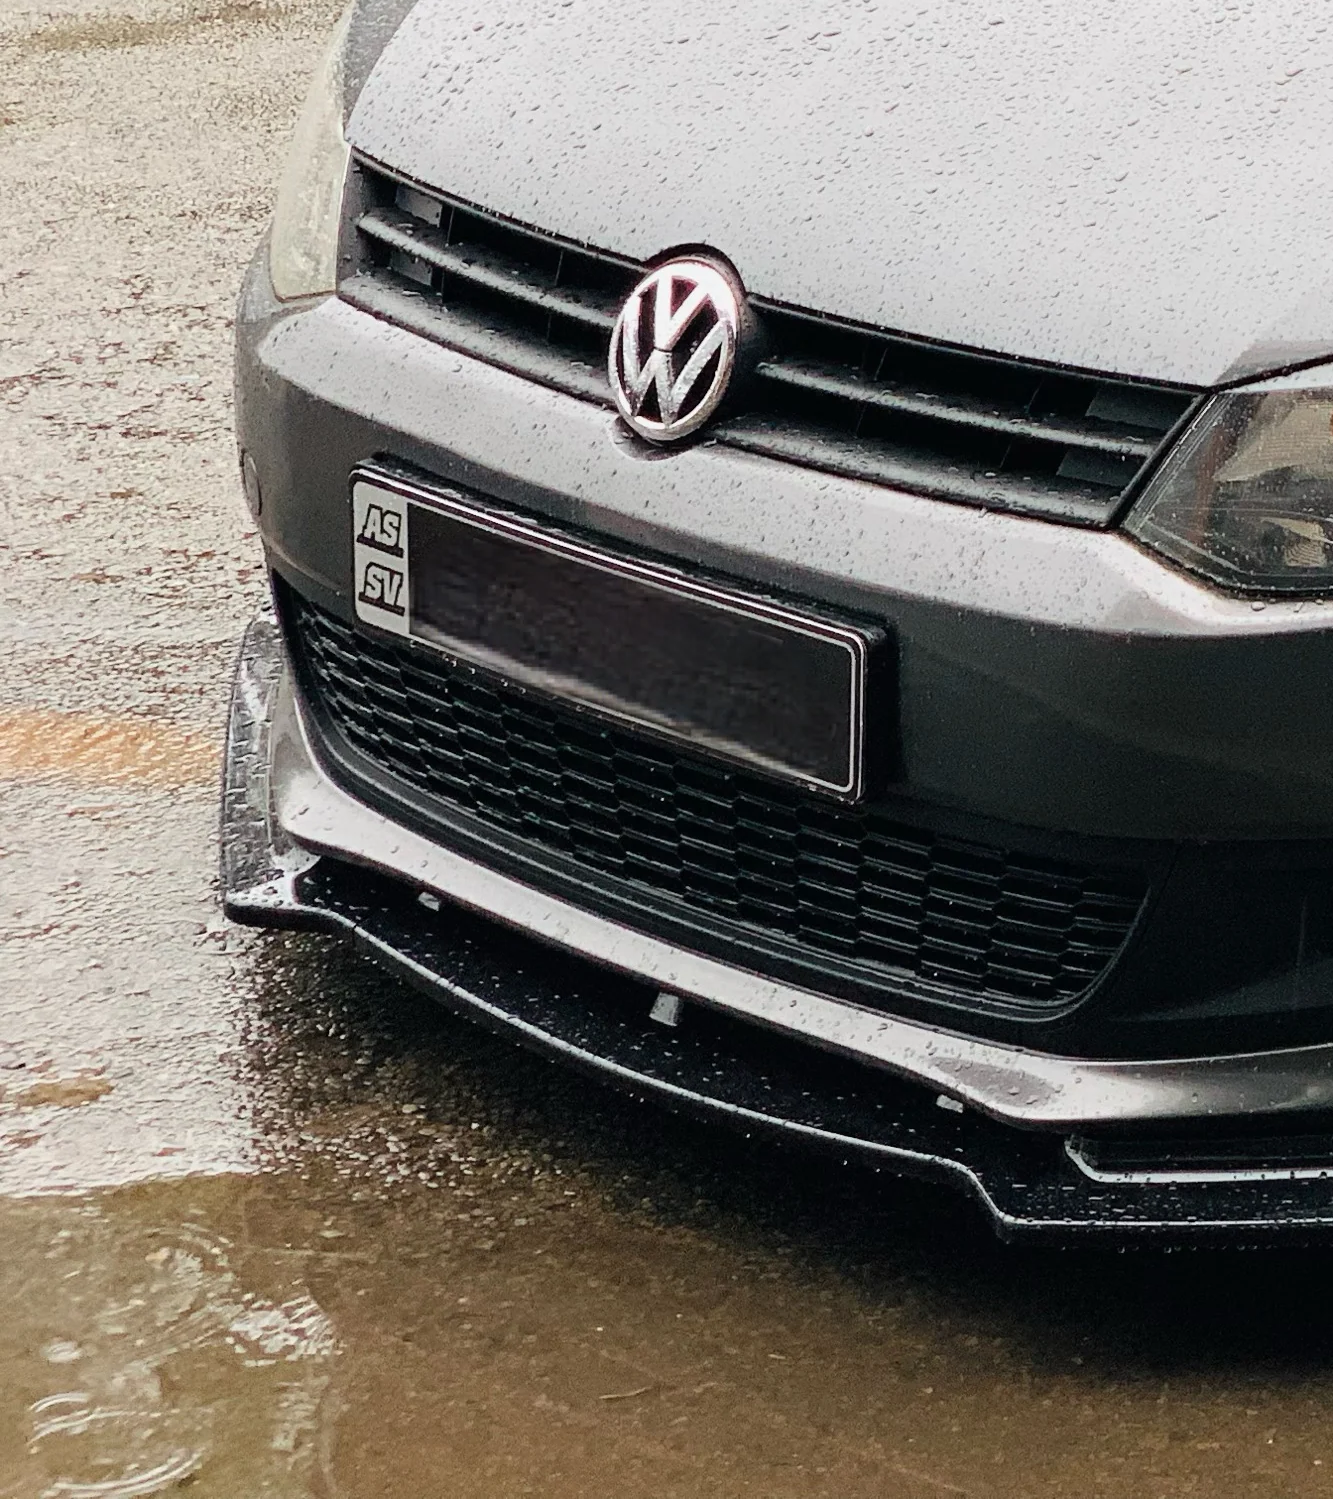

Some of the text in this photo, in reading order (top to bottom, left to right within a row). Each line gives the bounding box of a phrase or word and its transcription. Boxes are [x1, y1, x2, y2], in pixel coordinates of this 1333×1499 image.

[614, 262, 737, 432] VW
[360, 504, 403, 553] AS
[361, 562, 404, 612] SV
